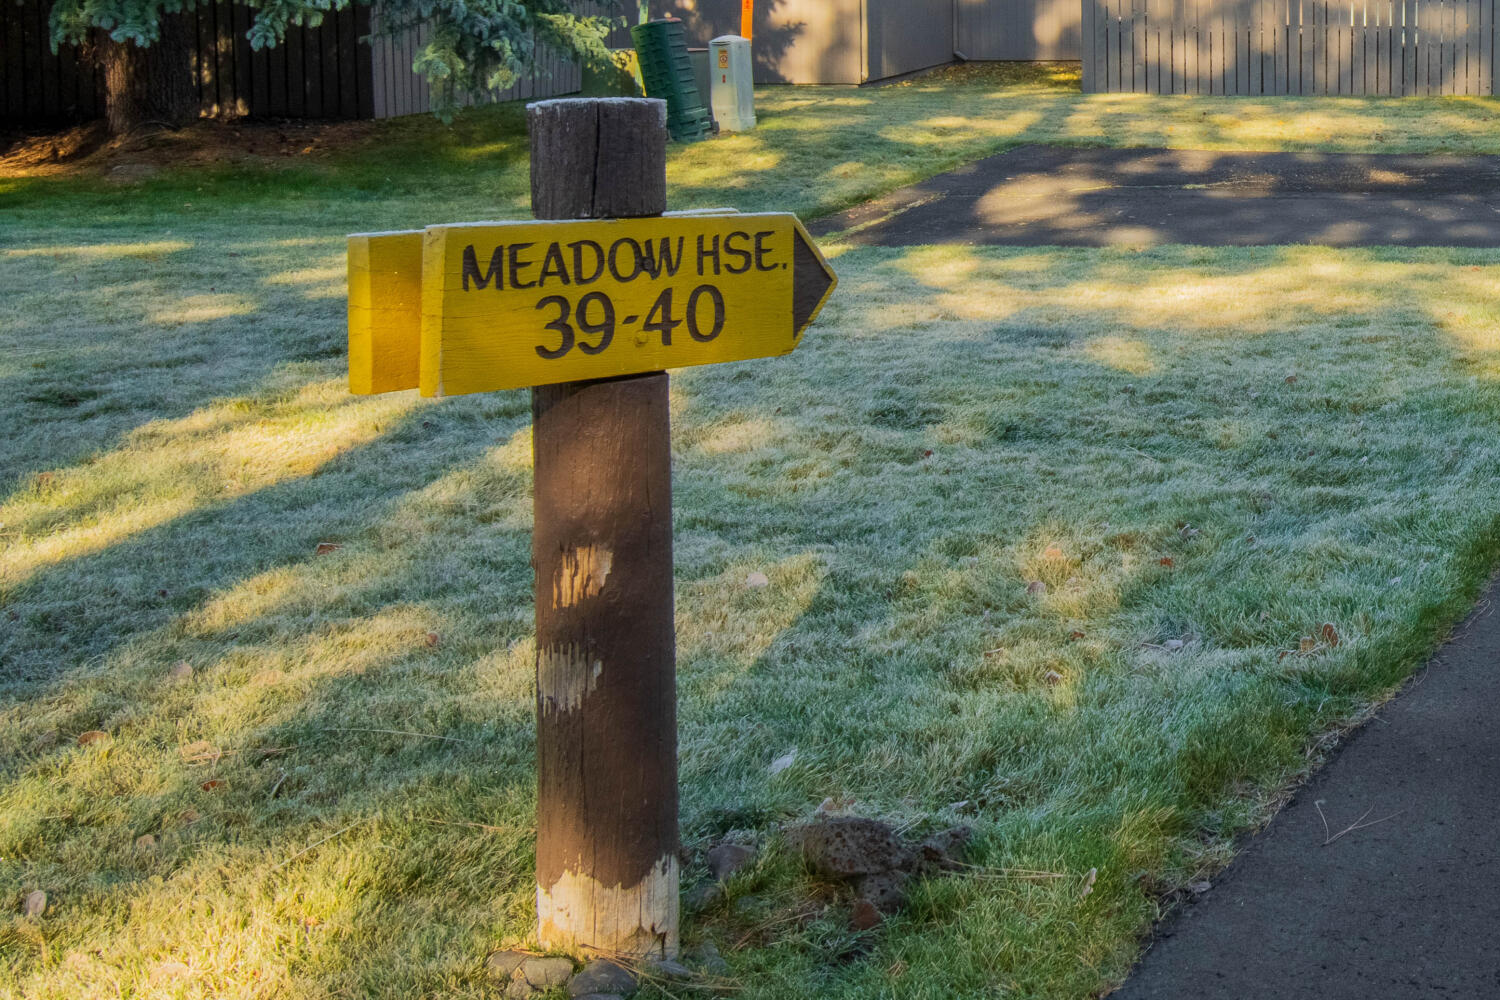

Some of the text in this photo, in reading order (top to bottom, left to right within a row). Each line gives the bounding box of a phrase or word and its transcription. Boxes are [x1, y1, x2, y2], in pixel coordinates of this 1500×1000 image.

[463, 231, 788, 291] MEADOW HSE.
[535, 284, 725, 359] 39-40
